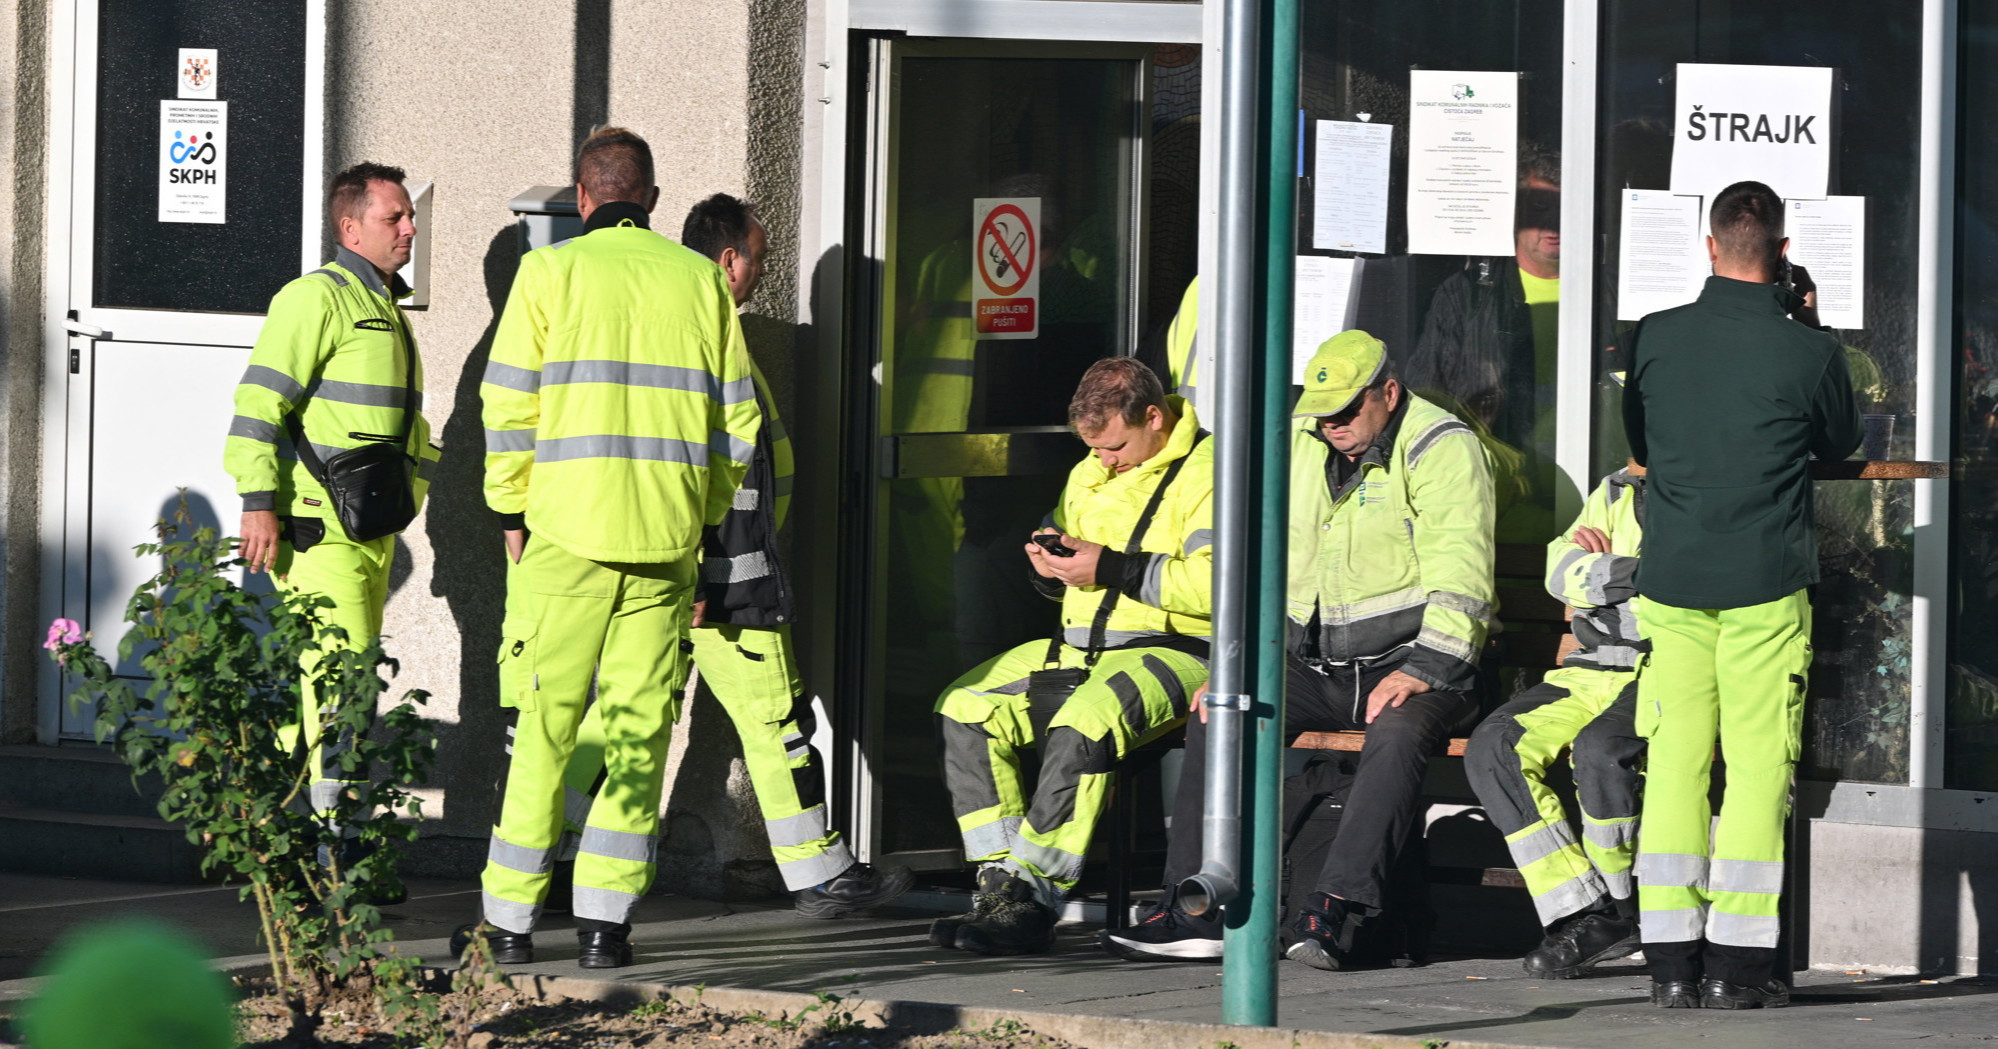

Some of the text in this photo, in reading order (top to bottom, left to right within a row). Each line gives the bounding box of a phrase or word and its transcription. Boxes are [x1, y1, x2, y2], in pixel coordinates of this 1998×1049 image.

[1687, 104, 1817, 145] ŠTRAJK
[169, 168, 216, 185] SKPH
[981, 305, 1029, 315] ZABRANJENO
[993, 316, 1017, 327] PUŠITI
